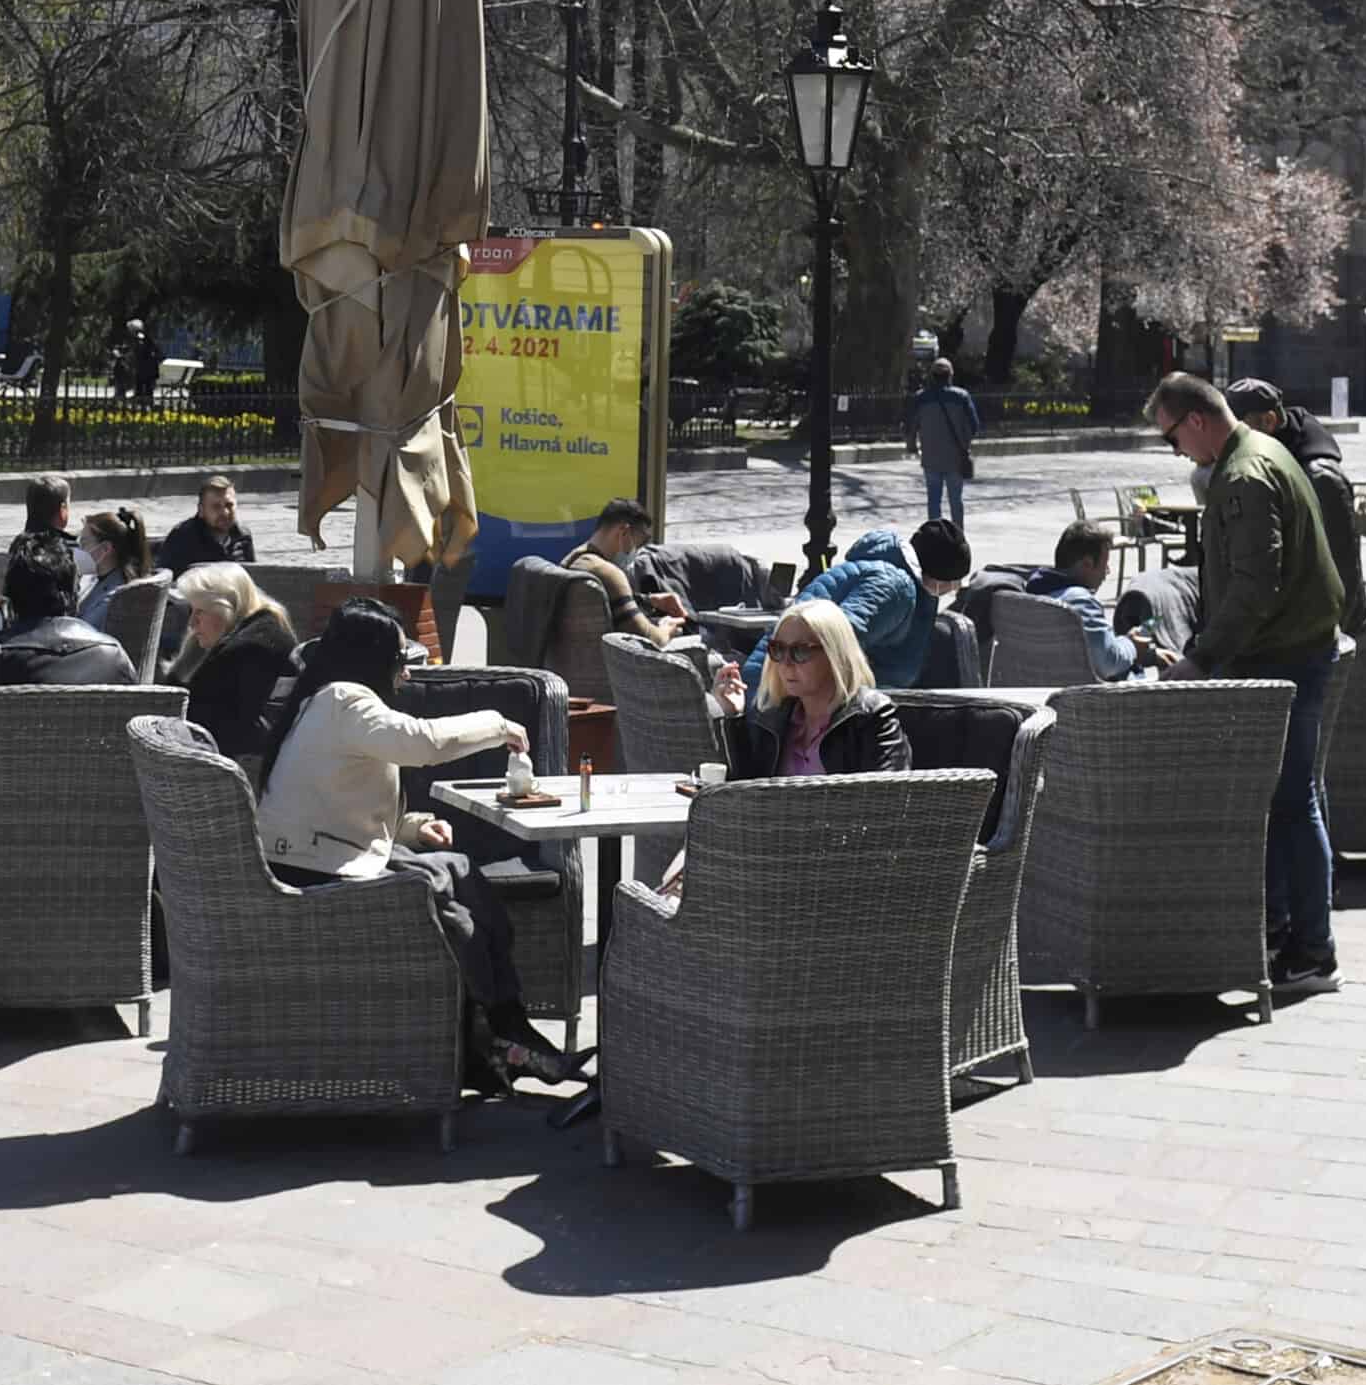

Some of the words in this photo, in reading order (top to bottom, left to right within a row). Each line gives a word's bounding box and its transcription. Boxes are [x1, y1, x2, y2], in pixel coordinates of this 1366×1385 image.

[506, 226, 556, 238] JCDecaux
[510, 337, 560, 358] 2021
[500, 407, 563, 429] Košice,
[499, 433, 561, 453] Hlavná
[566, 437, 609, 456] ulica
